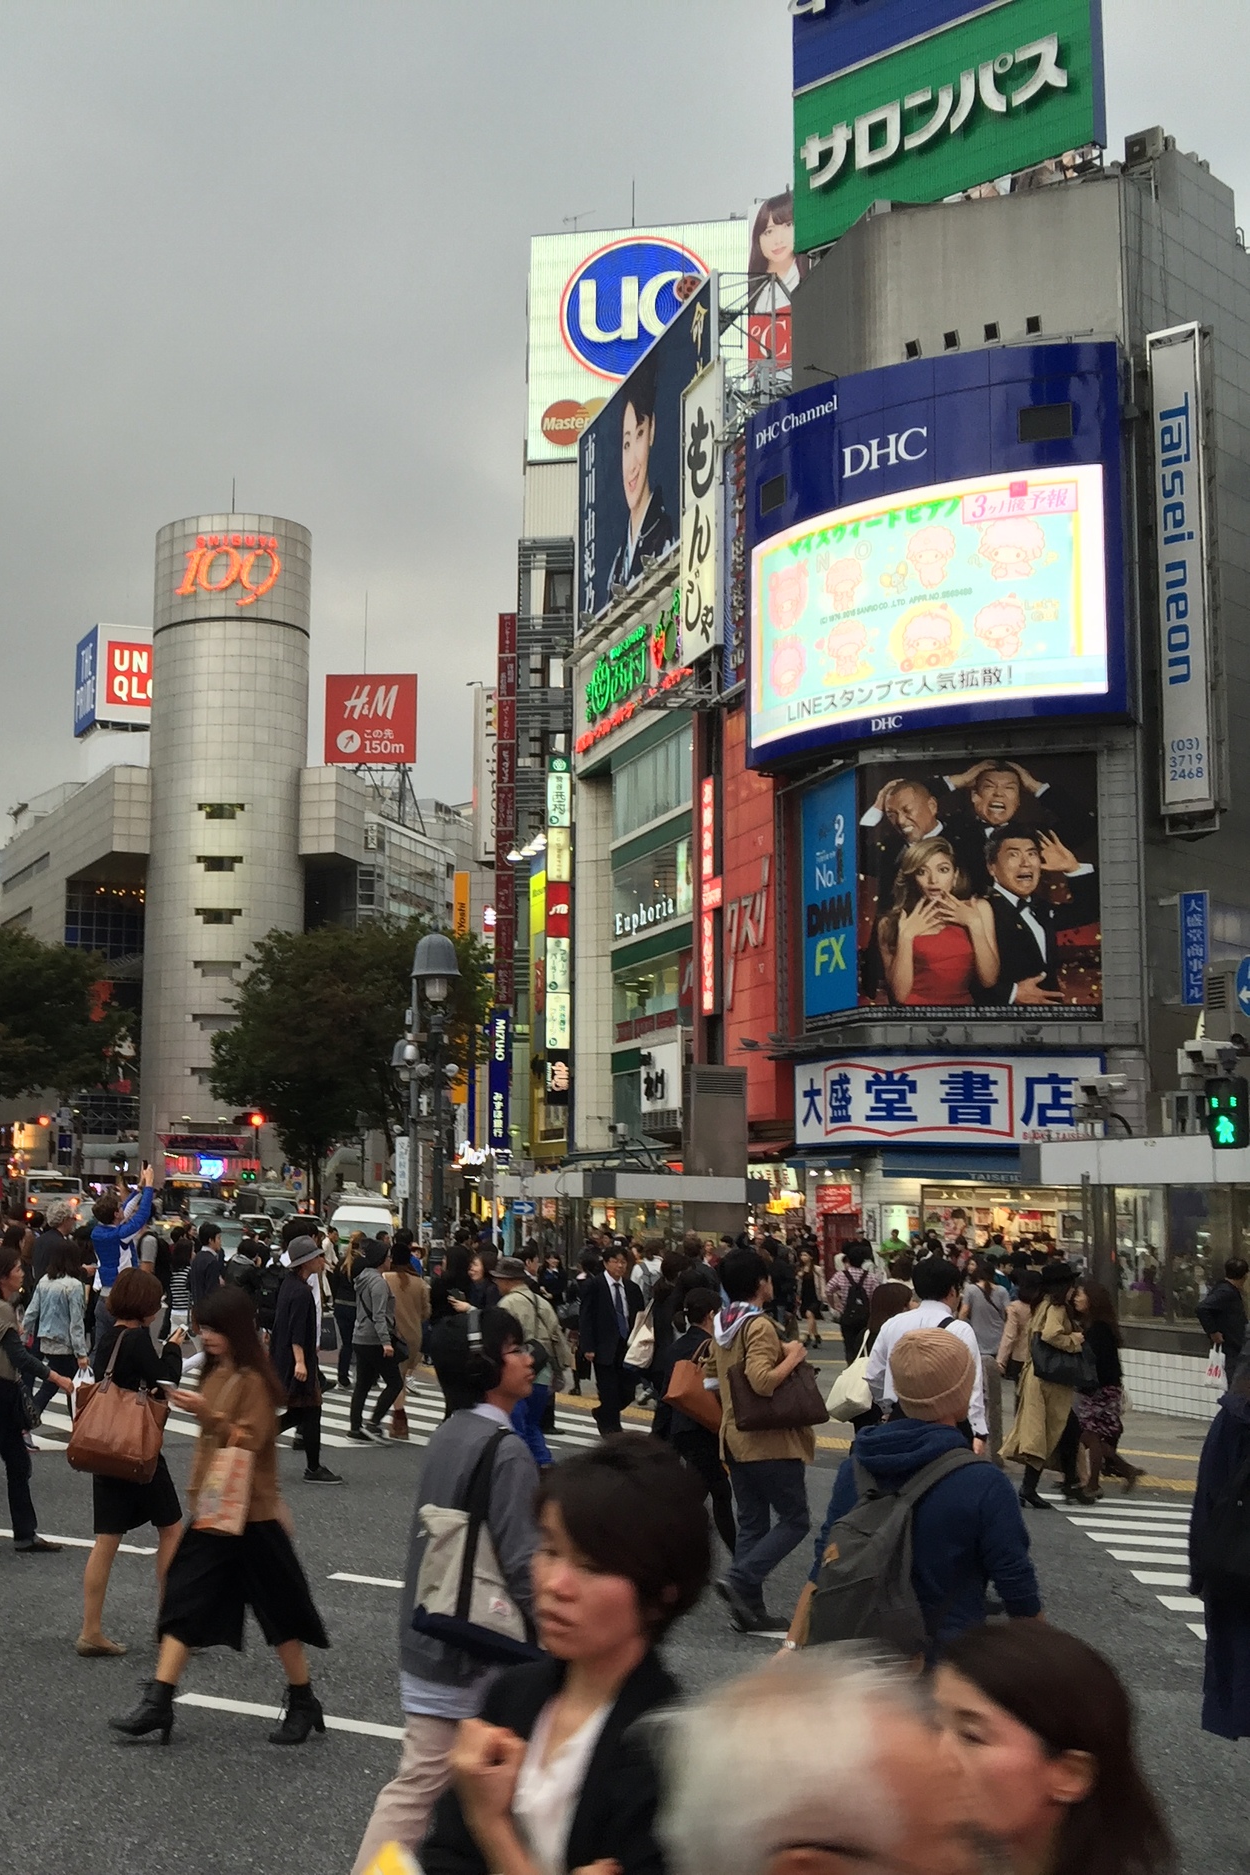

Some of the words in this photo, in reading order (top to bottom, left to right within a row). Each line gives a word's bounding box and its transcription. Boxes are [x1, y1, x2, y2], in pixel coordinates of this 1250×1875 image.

[800, 32, 1067, 189] サロンパス
[579, 270, 686, 343] UC
[755, 422, 780, 449] DHC
[781, 394, 838, 433] Channel
[842, 427, 928, 478] DHC
[1159, 392, 1193, 546] Taisei
[196, 534, 279, 550] SHIBUYA
[686, 405, 716, 643] もんじゃ
[175, 546, 282, 606] 109
[1164, 559, 1192, 686] neon
[113, 649, 149, 674] UN
[344, 684, 399, 721] H&M
[871, 715, 903, 732] DHC
[363, 728, 395, 740] この先
[364, 741, 405, 754] 150m
[1171, 736, 1200, 753] (03)
[1169, 753, 1203, 768] 3719
[1169, 766, 1204, 781] 2468
[549, 903, 569, 915] JTB
[615, 898, 674, 936] Euphoria
[807, 891, 853, 938] DMM
[815, 934, 847, 976] FX
[494, 1018, 506, 1061] MIZUHO
[802, 1070, 1079, 1126] 大盛堂書店
